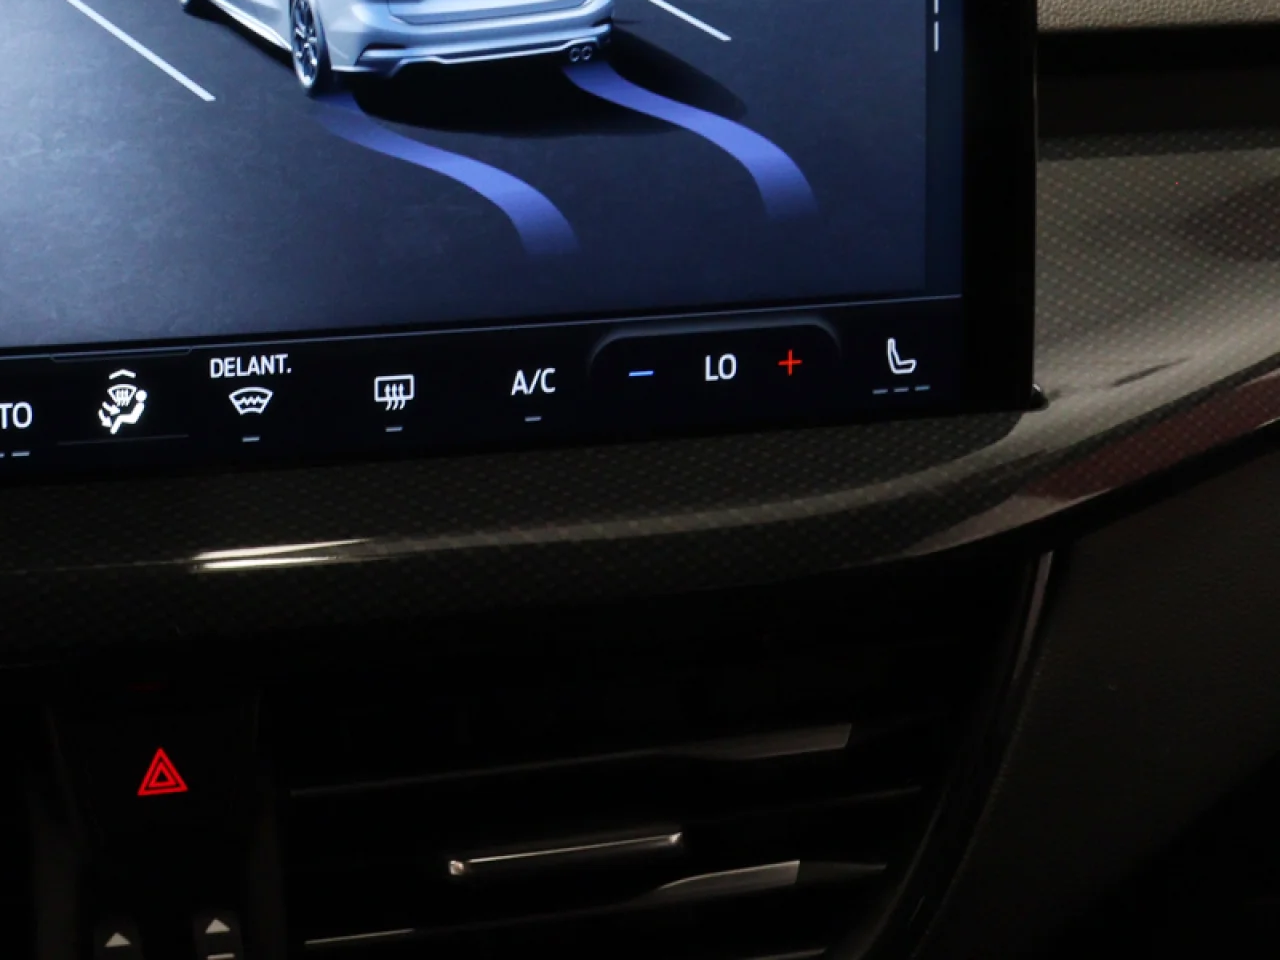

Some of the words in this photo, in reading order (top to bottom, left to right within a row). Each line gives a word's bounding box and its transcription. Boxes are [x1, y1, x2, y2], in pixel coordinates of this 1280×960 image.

[210, 353, 292, 379] DELANT.
[705, 353, 738, 382] LO
[511, 367, 557, 397] A/C
